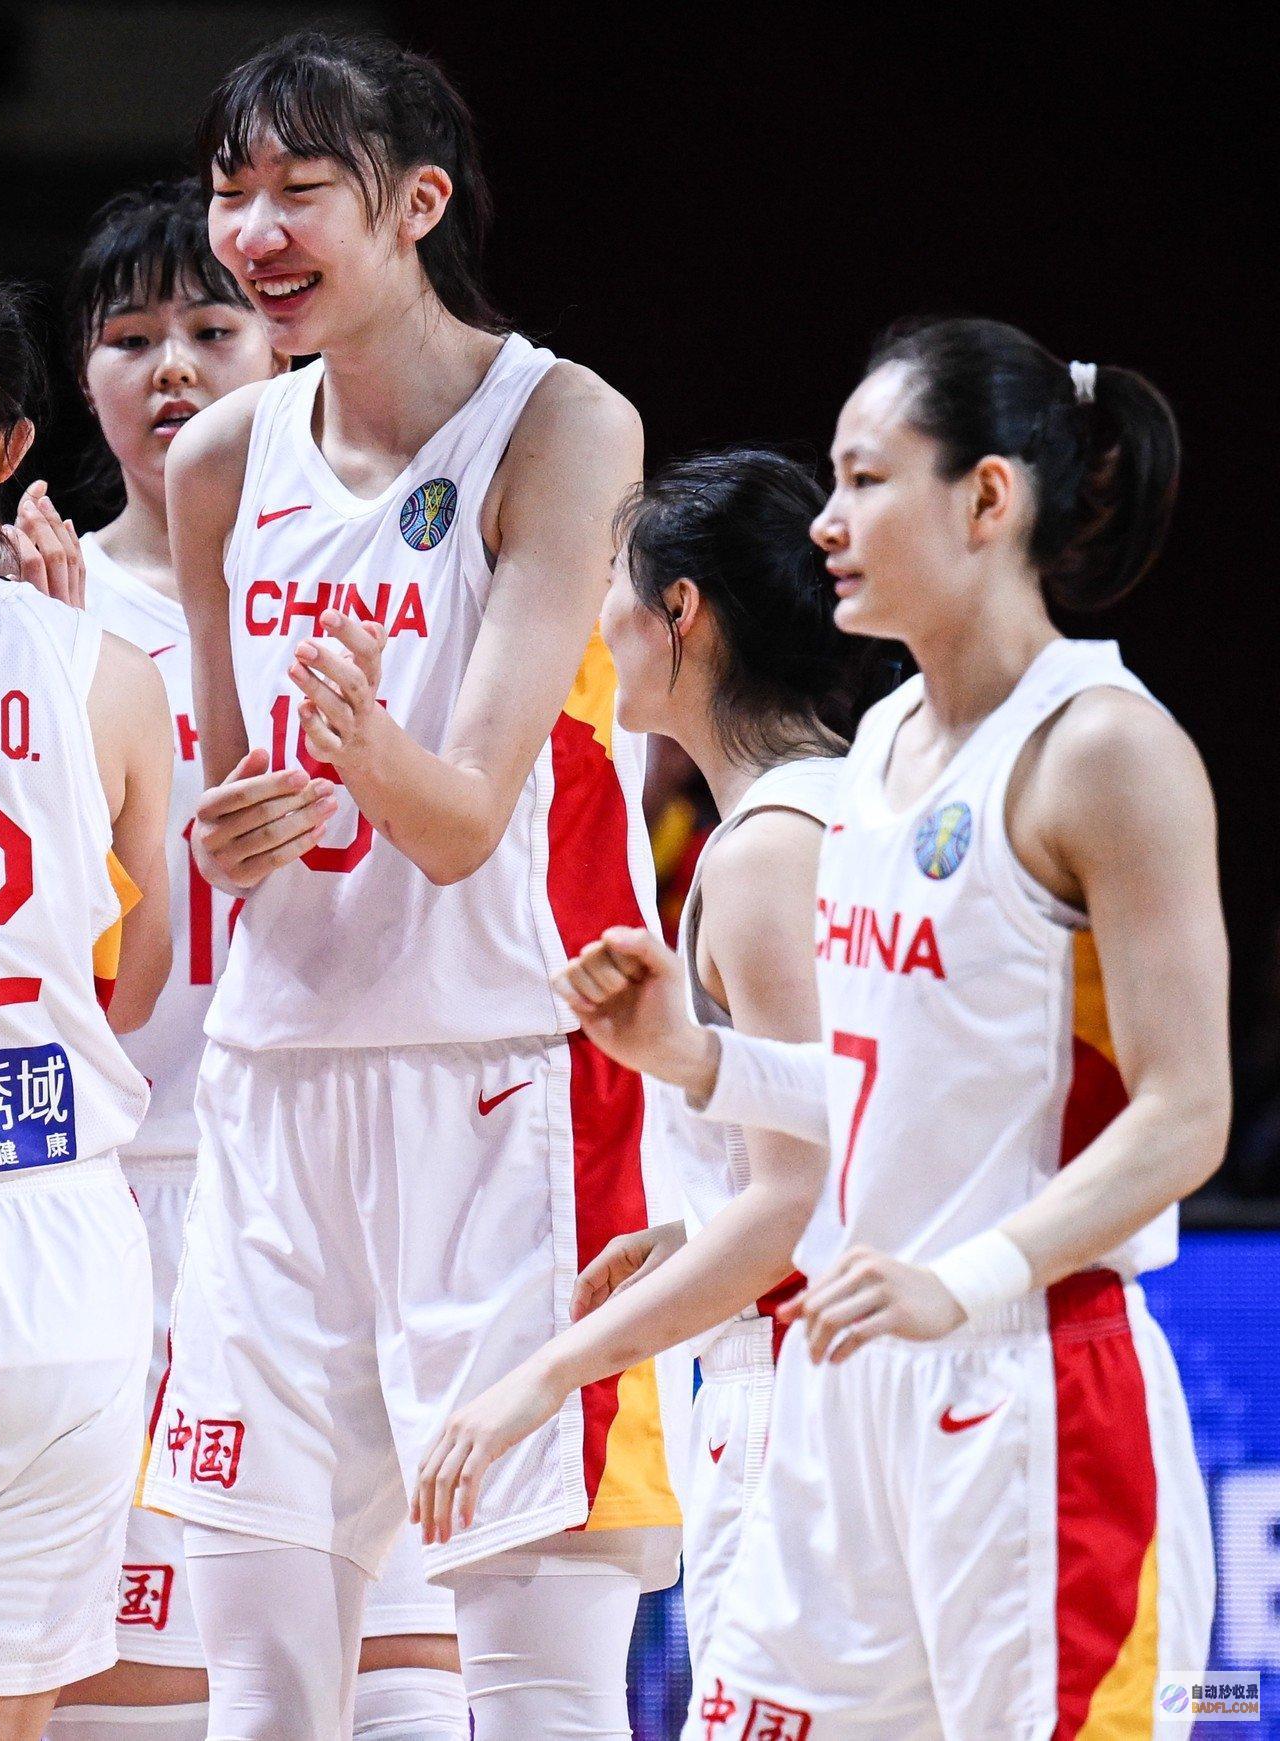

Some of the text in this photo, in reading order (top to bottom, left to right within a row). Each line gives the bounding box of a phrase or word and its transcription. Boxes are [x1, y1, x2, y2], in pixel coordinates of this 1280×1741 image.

[245, 580, 428, 638] CHINA
[1, 690, 41, 762] Q.
[832, 1030, 880, 1227] 7
[168, 1408, 245, 1489] 中国
